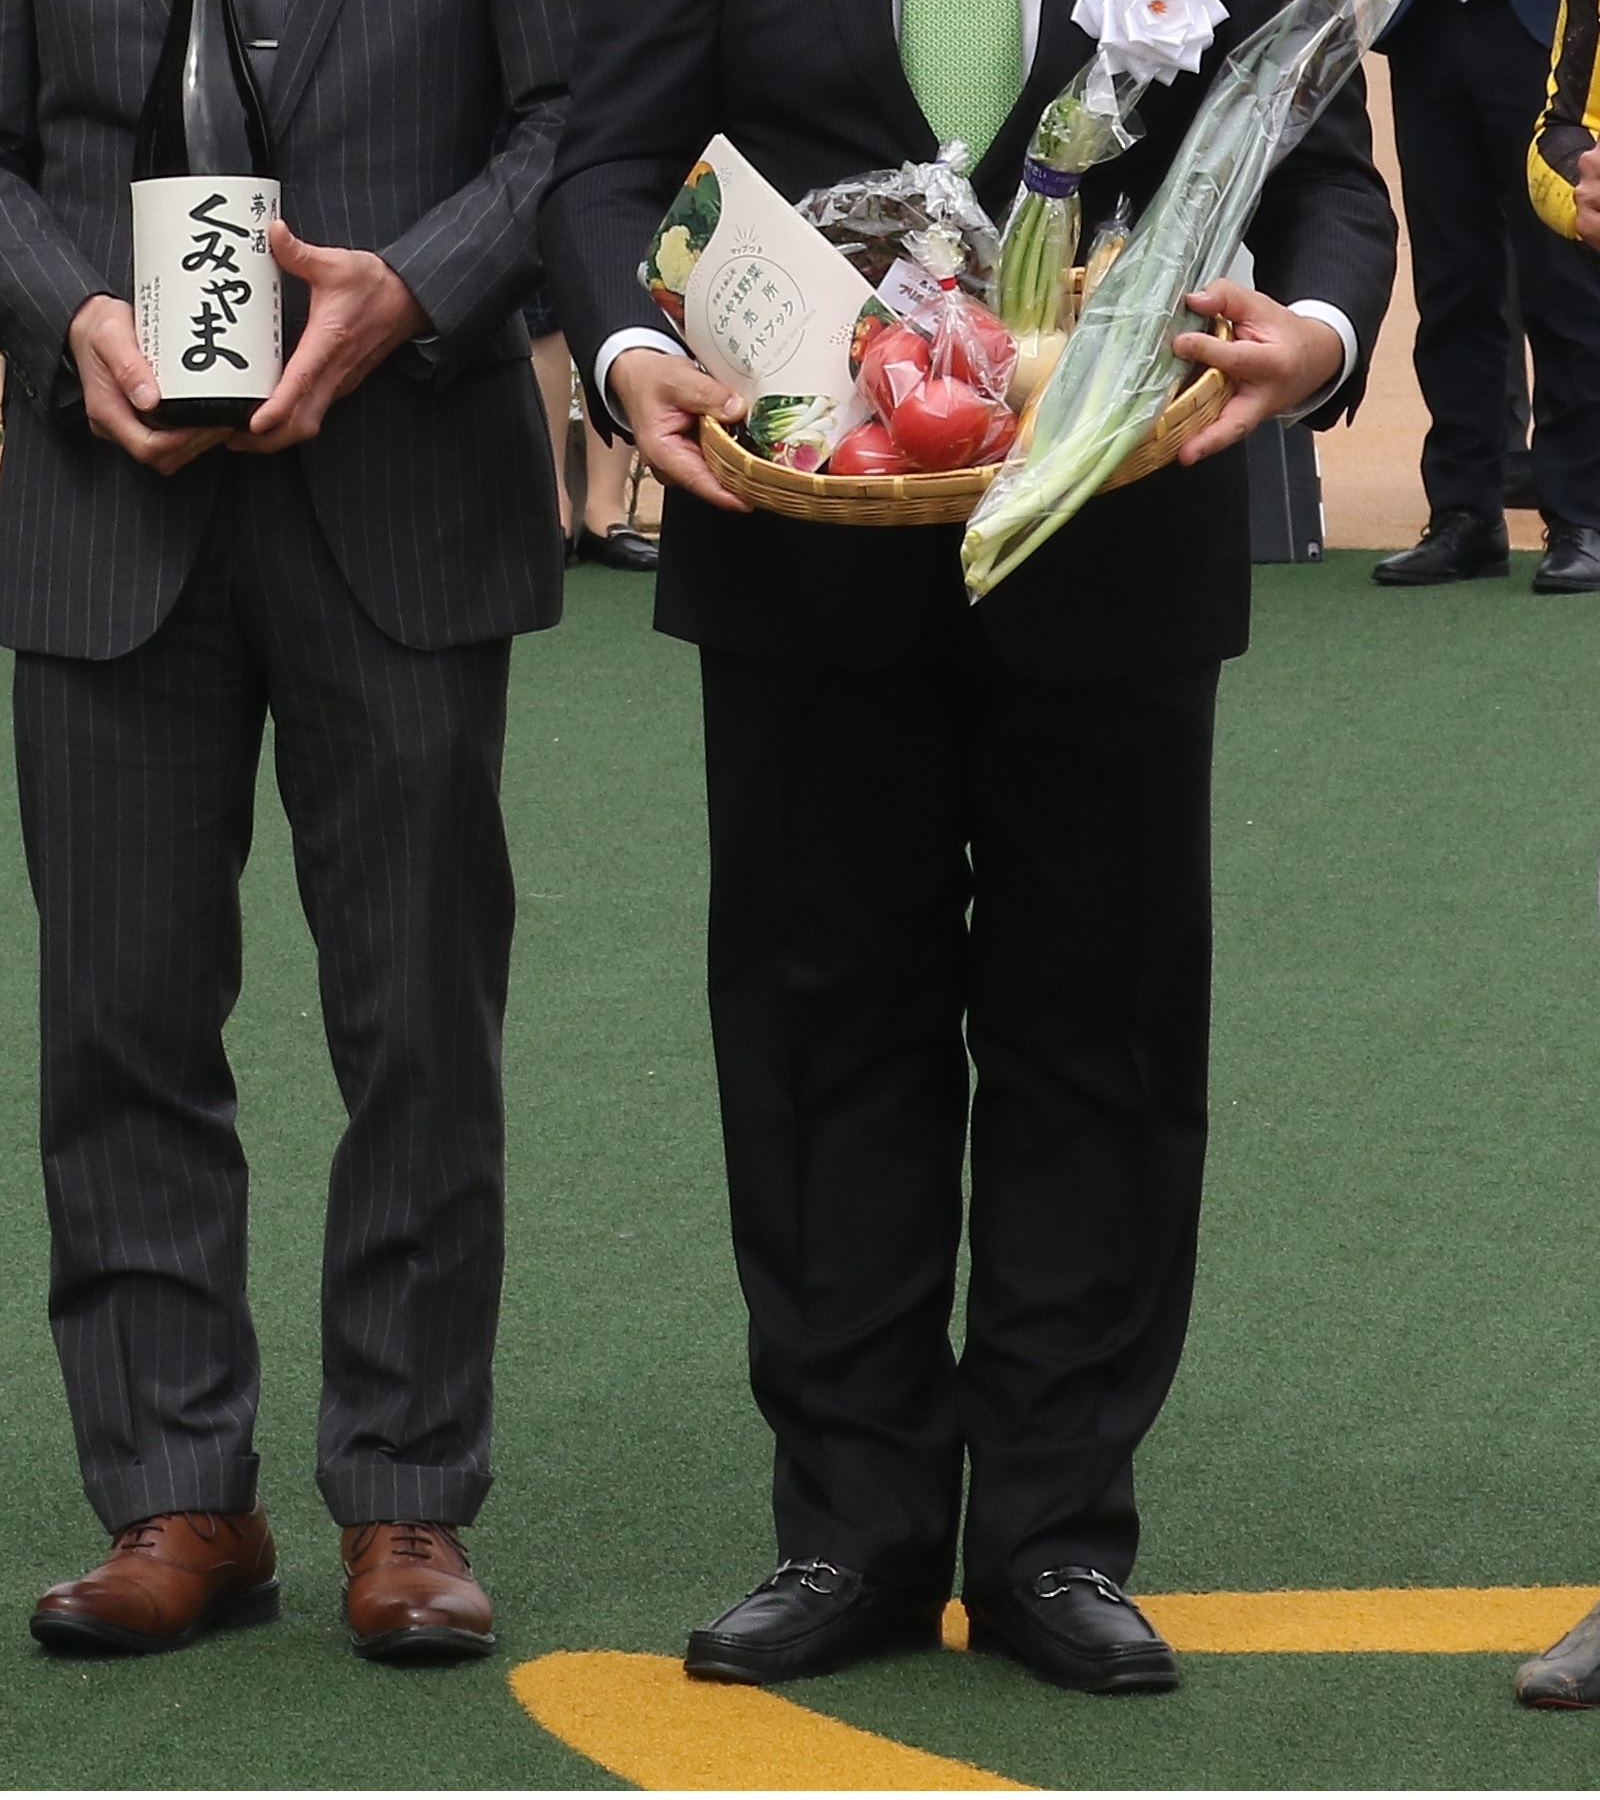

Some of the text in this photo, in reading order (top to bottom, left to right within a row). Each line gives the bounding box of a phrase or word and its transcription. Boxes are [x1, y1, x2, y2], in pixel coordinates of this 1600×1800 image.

[250, 192, 268, 254] 夢酒
[181, 193, 252, 372] くみやま
[714, 262, 763, 335] くみやま野菜
[742, 300, 794, 372] ガイドブック
